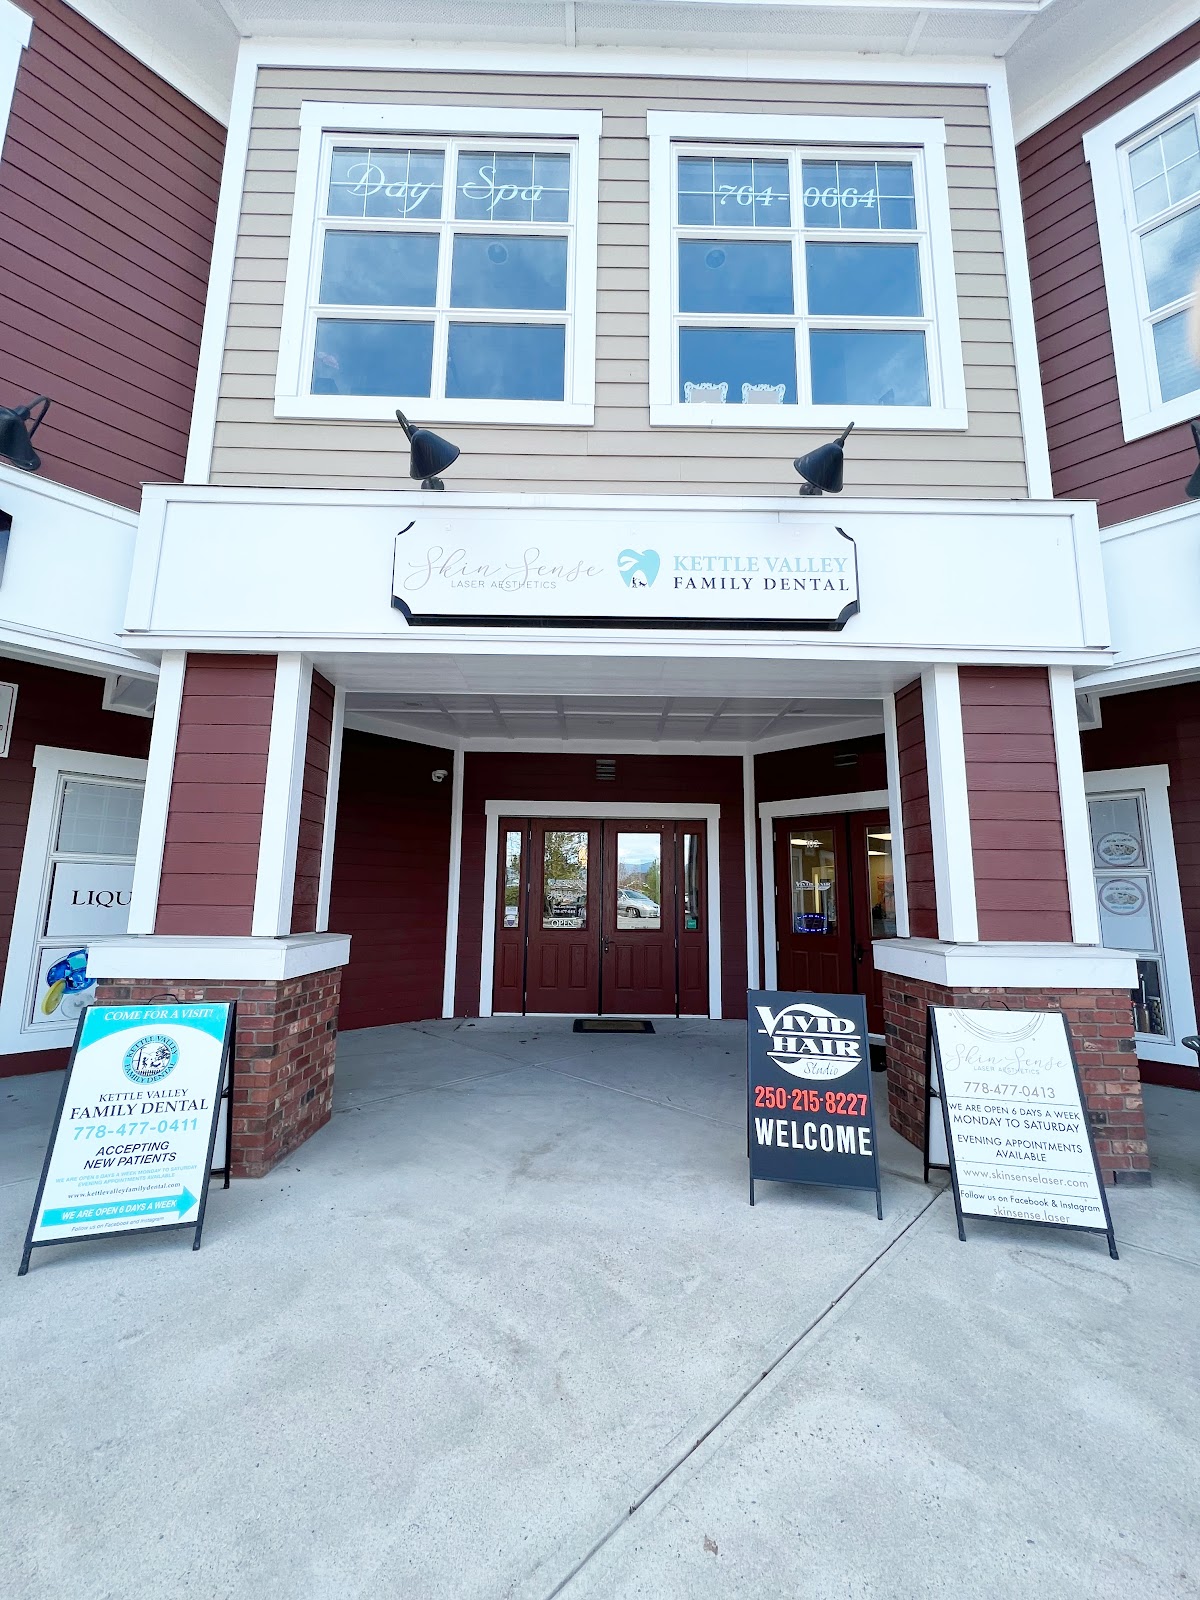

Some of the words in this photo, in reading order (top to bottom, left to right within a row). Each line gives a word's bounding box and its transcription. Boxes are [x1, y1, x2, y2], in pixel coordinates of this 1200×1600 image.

[346, 163, 435, 213] Day
[463, 165, 543, 211] Spa
[404, 546, 501, 590] Skin
[502, 547, 604, 592] Sense
[673, 556, 760, 572] KETTLE
[764, 557, 848, 573] VALLEY
[451, 580, 485, 588] LASER
[490, 580, 557, 589] AESTHETICS
[673, 576, 754, 590] FAMILY
[763, 577, 850, 591] DENTAL
[551, 919, 575, 927] OPEN
[104, 1010, 142, 1021] COME
[143, 1009, 168, 1020] FOR
[170, 1009, 179, 1019] A
[181, 1008, 214, 1018] VISIT!
[754, 1005, 856, 1037] VIVID
[126, 1035, 155, 1058] KETTLE
[156, 1035, 179, 1056] VALLEY
[772, 1036, 861, 1057] HAIR
[803, 1061, 839, 1076] Studio
[944, 1043, 1002, 1071] Skin
[1003, 1046, 1068, 1076] Sense
[124, 1063, 146, 1084] FAMILY
[146, 1062, 176, 1084] DENTAL
[998, 1066, 1040, 1075] AESTHETICS
[98, 1091, 144, 1103] KETTLE
[146, 1088, 189, 1099] VALLEY
[964, 1081, 1056, 1099] 778-477-0413
[69, 1103, 138, 1120] FAMILY
[140, 1098, 209, 1115] DENTAL
[948, 1102, 963, 1111] WE
[965, 1104, 982, 1112] ARE
[984, 1105, 1009, 1114] OPEN
[1012, 1106, 1017, 1116] 6
[1020, 1108, 1043, 1118] DAYS
[1044, 1110, 1052, 1118] A
[1054, 1110, 1081, 1120] WEEK
[73, 1118, 198, 1141] 778-477-0411
[953, 1114, 1002, 1127] MONDAY
[1005, 1118, 1020, 1129] TO
[1024, 1119, 1080, 1133] SATURDAY
[754, 1117, 873, 1156] WELCOME
[957, 1134, 1002, 1146] EVENING
[1005, 1139, 1083, 1154] APPOINTMENTS
[95, 1140, 170, 1156] ACCEPTING
[995, 1149, 1047, 1162] AVAILABLE
[84, 1157, 116, 1170] NEW
[116, 1152, 177, 1167] PATIENTS
[963, 1169, 1089, 1188] www.skinsenselaser.com
[68, 1182, 181, 1199] www.kettlevalleyfamilydental.com
[62, 1212, 75, 1220] WE
[76, 1210, 93, 1218] ARE
[95, 1207, 118, 1216] OPEN
[119, 1205, 124, 1213] 6
[125, 1204, 146, 1213] DAYS
[154, 1200, 178, 1209] WEEK
[960, 1190, 985, 1200] Follow
[1010, 1196, 1049, 1207] Facebook
[1051, 1200, 1058, 1208] &
[1060, 1201, 1100, 1213] Instagram
[993, 1205, 1071, 1223] skinsense.laser
